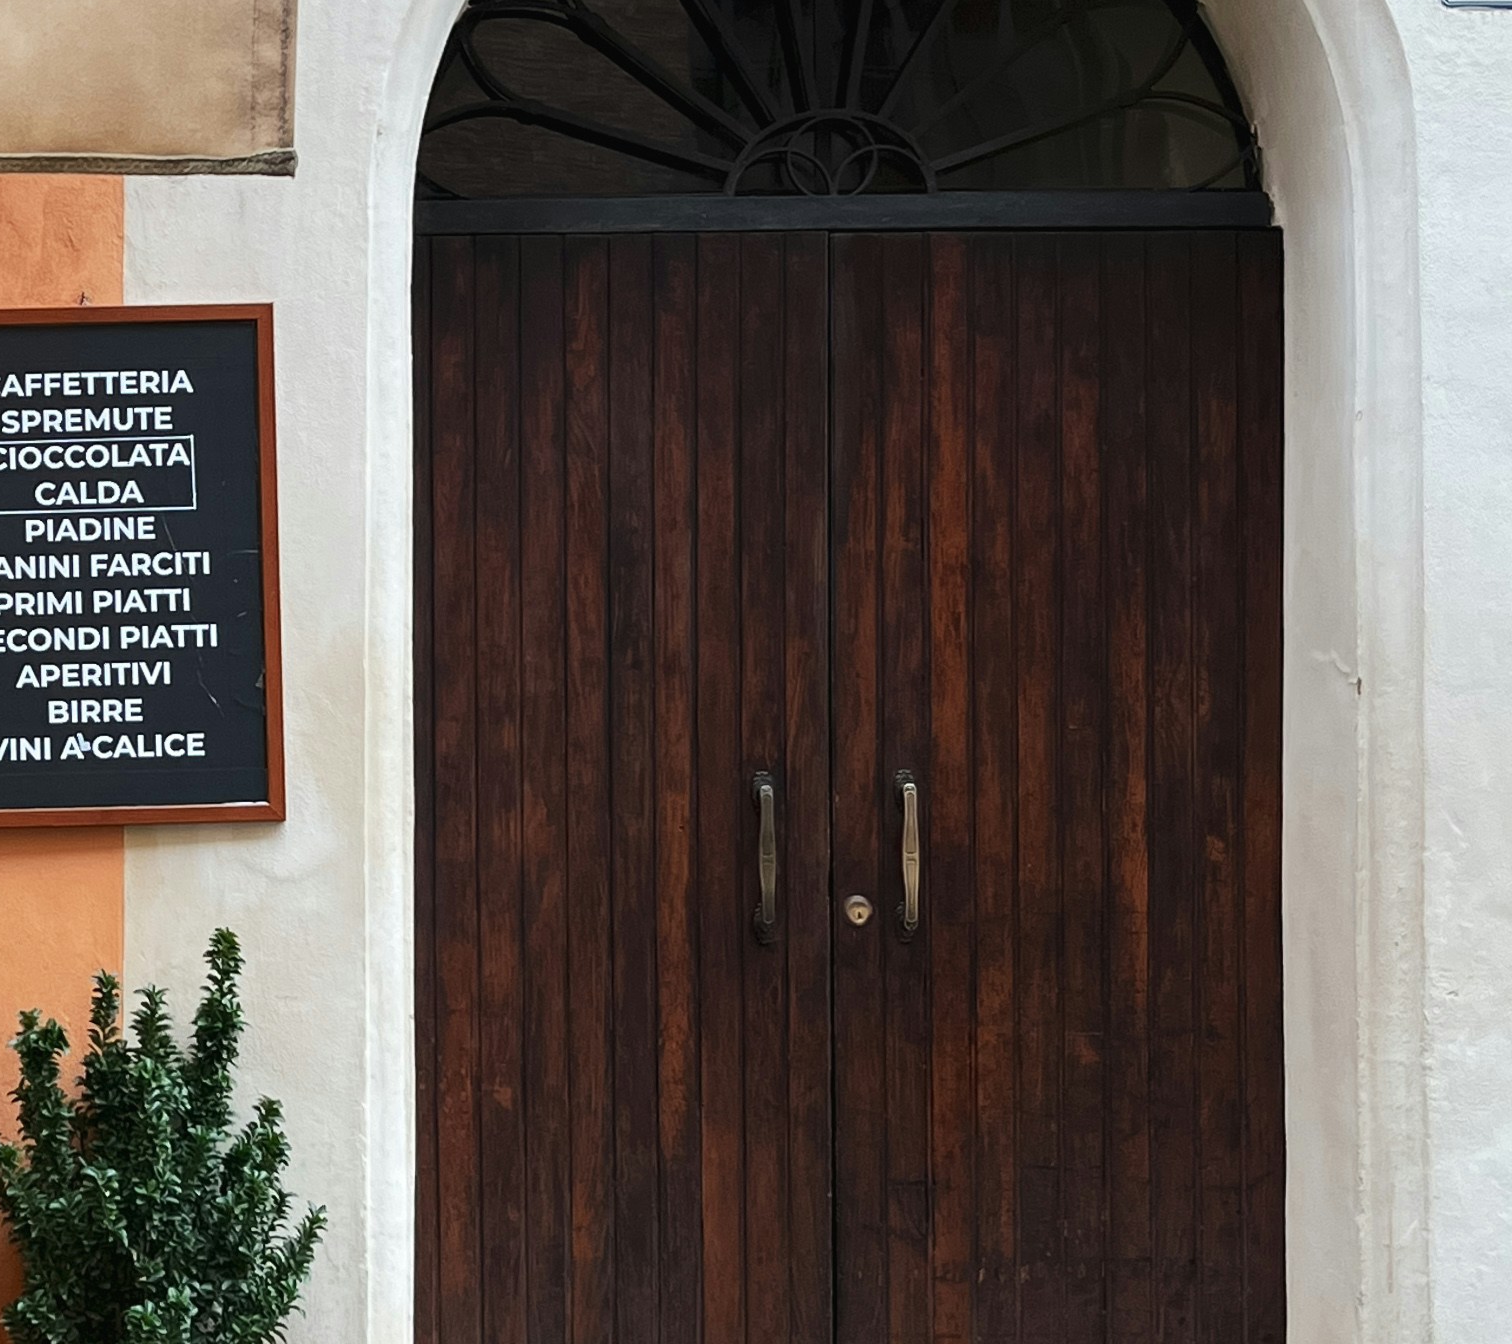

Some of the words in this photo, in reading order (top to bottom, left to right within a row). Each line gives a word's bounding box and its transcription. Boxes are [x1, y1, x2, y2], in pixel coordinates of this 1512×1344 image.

[1, 406, 173, 434] SPREMUTE
[34, 480, 145, 506] CALDA
[25, 515, 156, 543] PIADINE
[90, 551, 211, 578] FARCITI
[92, 587, 191, 614] PIATTI
[120, 623, 218, 650] PIATTI
[15, 661, 171, 689] APERITIVI
[48, 698, 144, 724] BIRRE
[91, 732, 206, 759] CALICE
